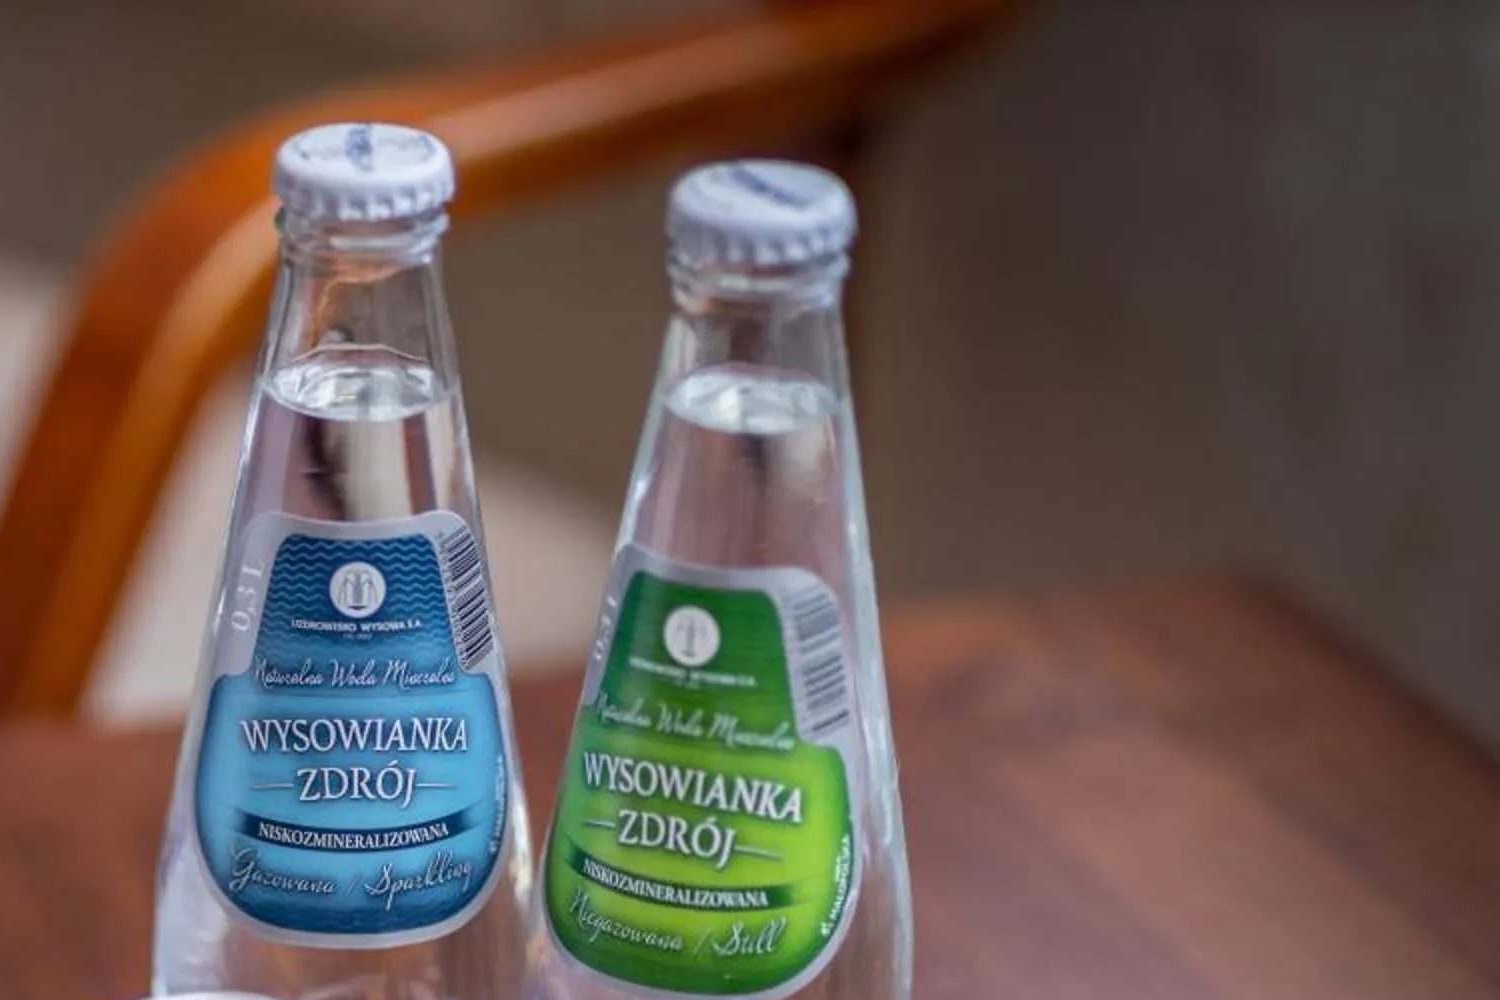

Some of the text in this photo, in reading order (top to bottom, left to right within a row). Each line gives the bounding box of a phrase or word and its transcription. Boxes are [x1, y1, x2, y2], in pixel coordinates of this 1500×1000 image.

[240, 717, 469, 752] WYSOWIANKA
[296, 760, 417, 808] ZDRÓJ
[583, 751, 803, 823] WYSOWIANKA
[258, 821, 450, 849] NISKOZMINERALIZOWANA
[617, 809, 737, 869] ZDRÓJ
[228, 848, 337, 893] Gazowana
[582, 857, 770, 909] NISKOZMINERALIZOWANA
